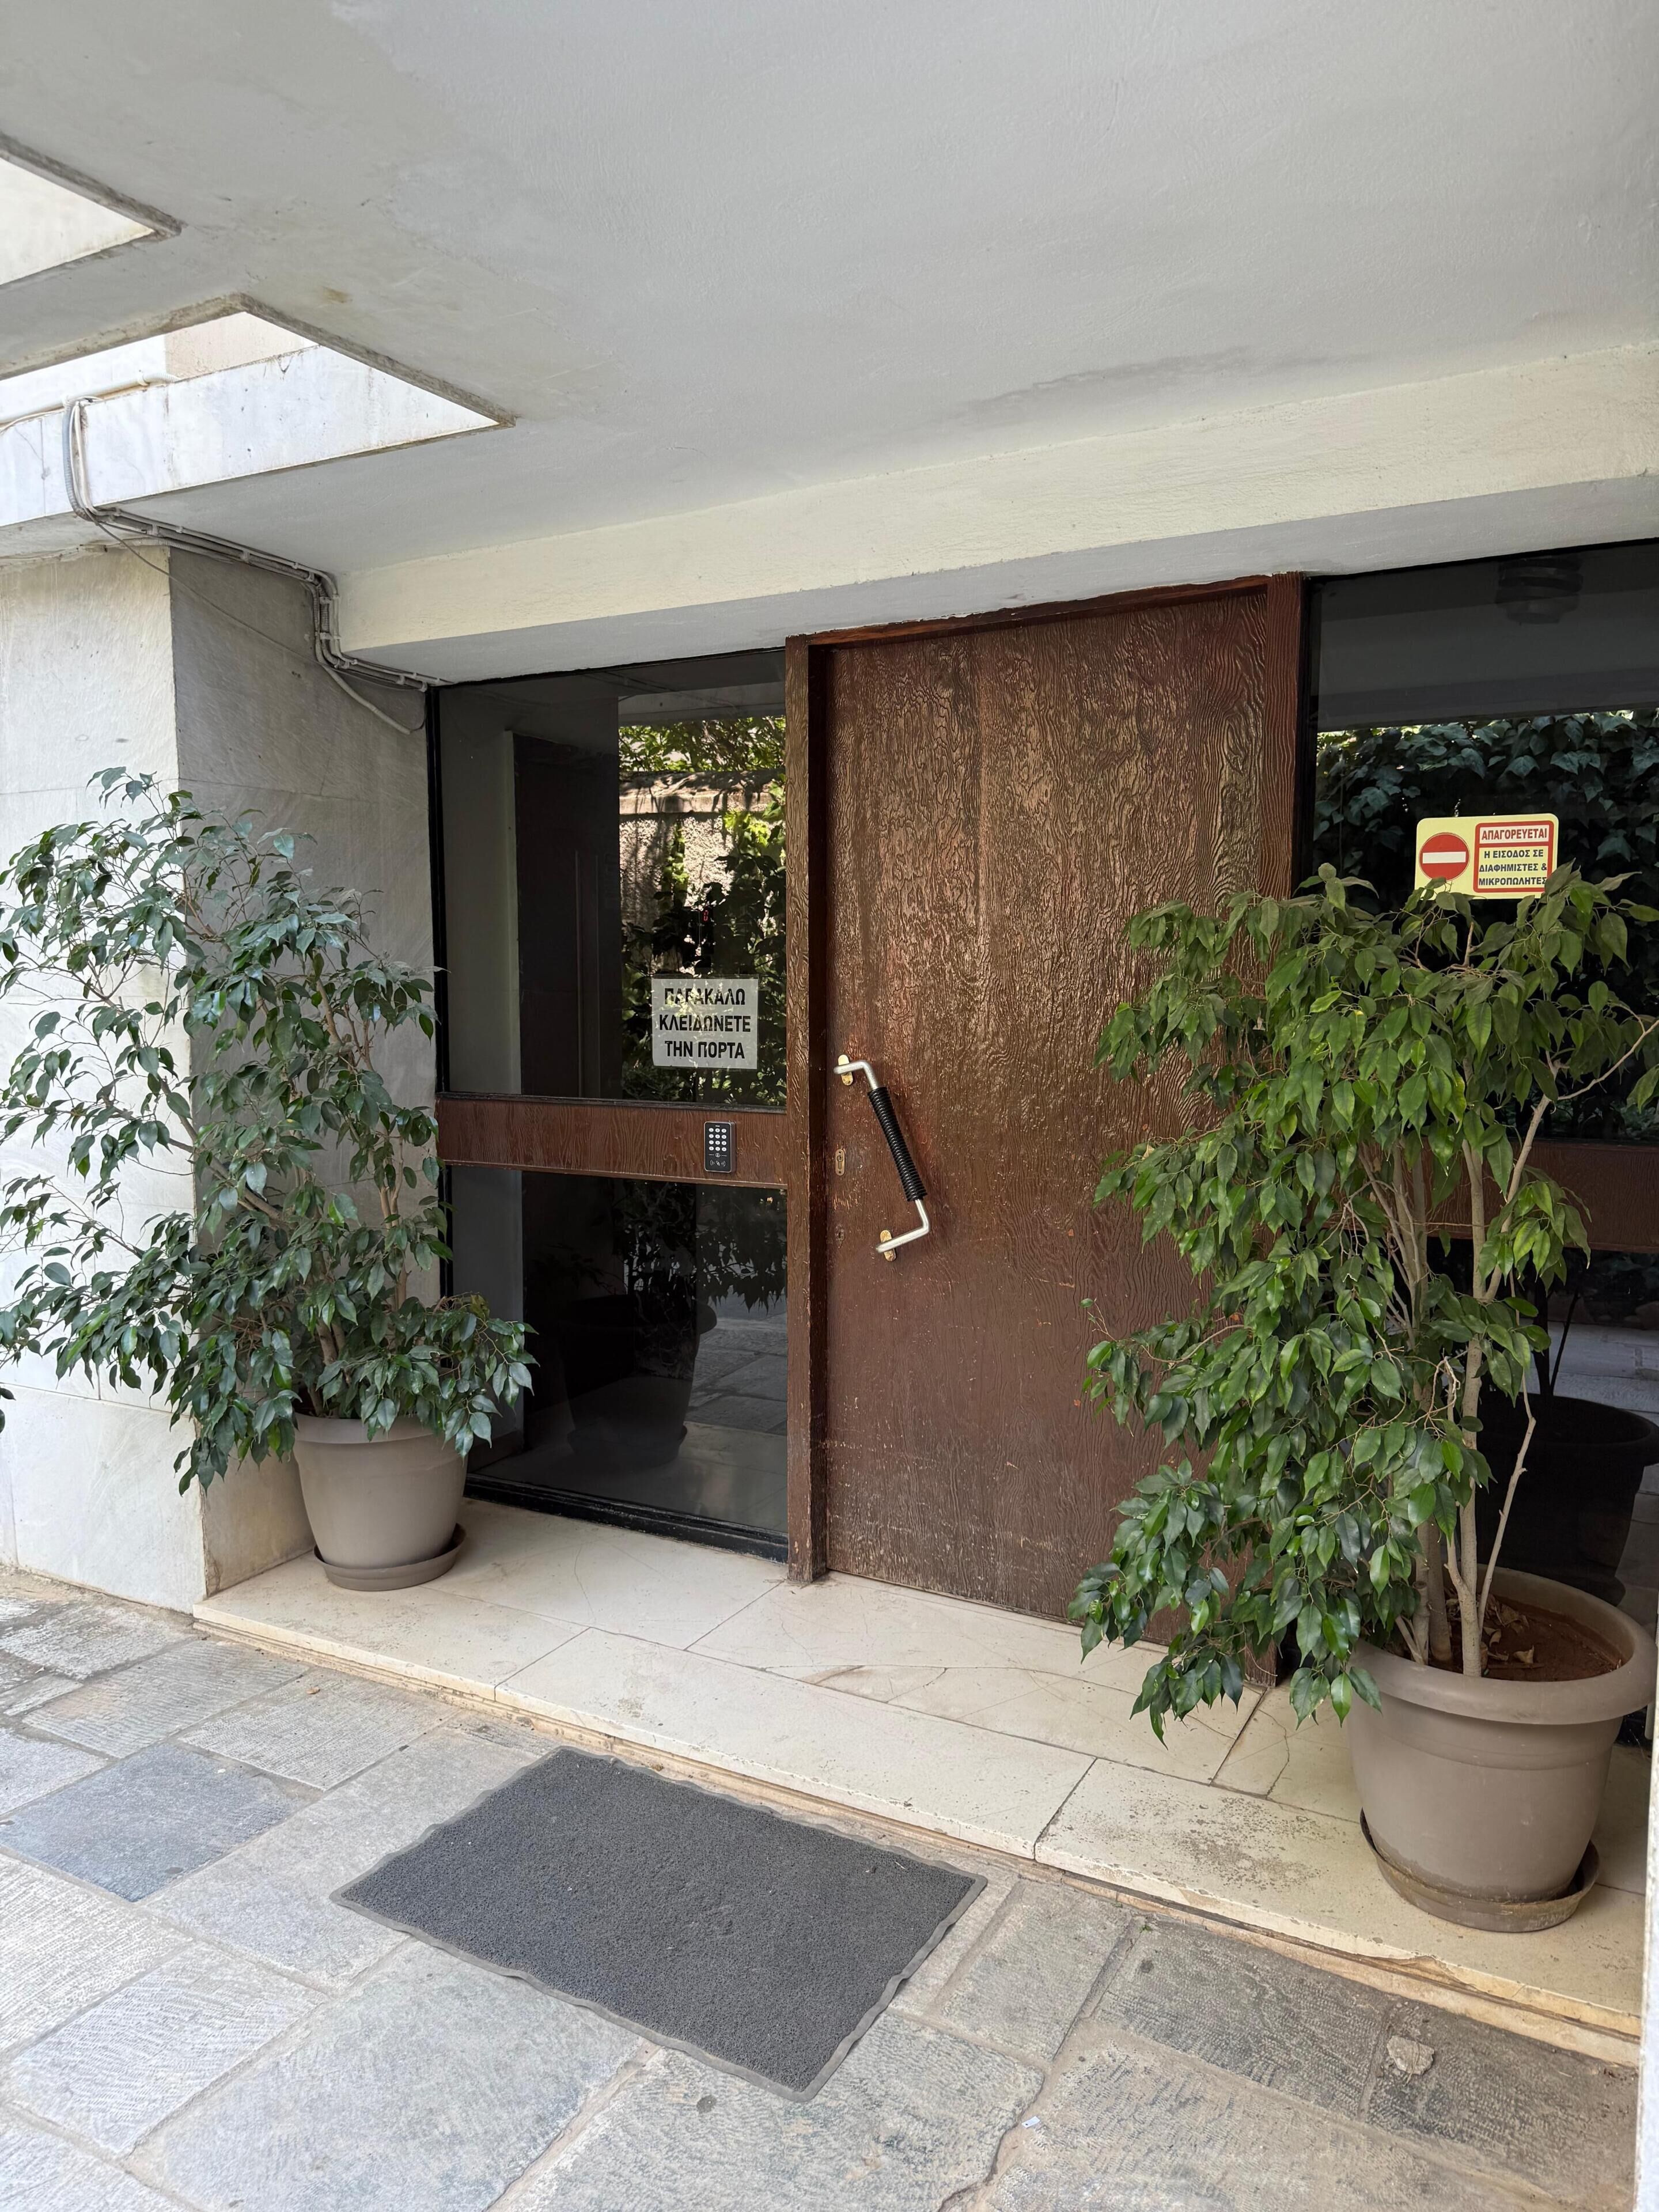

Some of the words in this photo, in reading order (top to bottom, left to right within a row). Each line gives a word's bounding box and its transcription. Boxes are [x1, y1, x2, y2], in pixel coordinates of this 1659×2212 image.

[1482, 828, 1547, 840] ΑΠΑΓΟΡΕΥΕΤΑΙ
[1493, 850, 1530, 858] ΕΙΣΟΔΟΣ
[1533, 849, 1544, 857] ΣΕ
[1479, 863, 1539, 872] ΔΙΑΦΗΜΙΣΤΕΣ
[660, 1014, 751, 1032] ΚΛΕΙΔΩΝΕΤΕ
[665, 1041, 692, 1057] ΤΗΝ
[698, 1041, 745, 1059] ΠΟΡΤΑ
